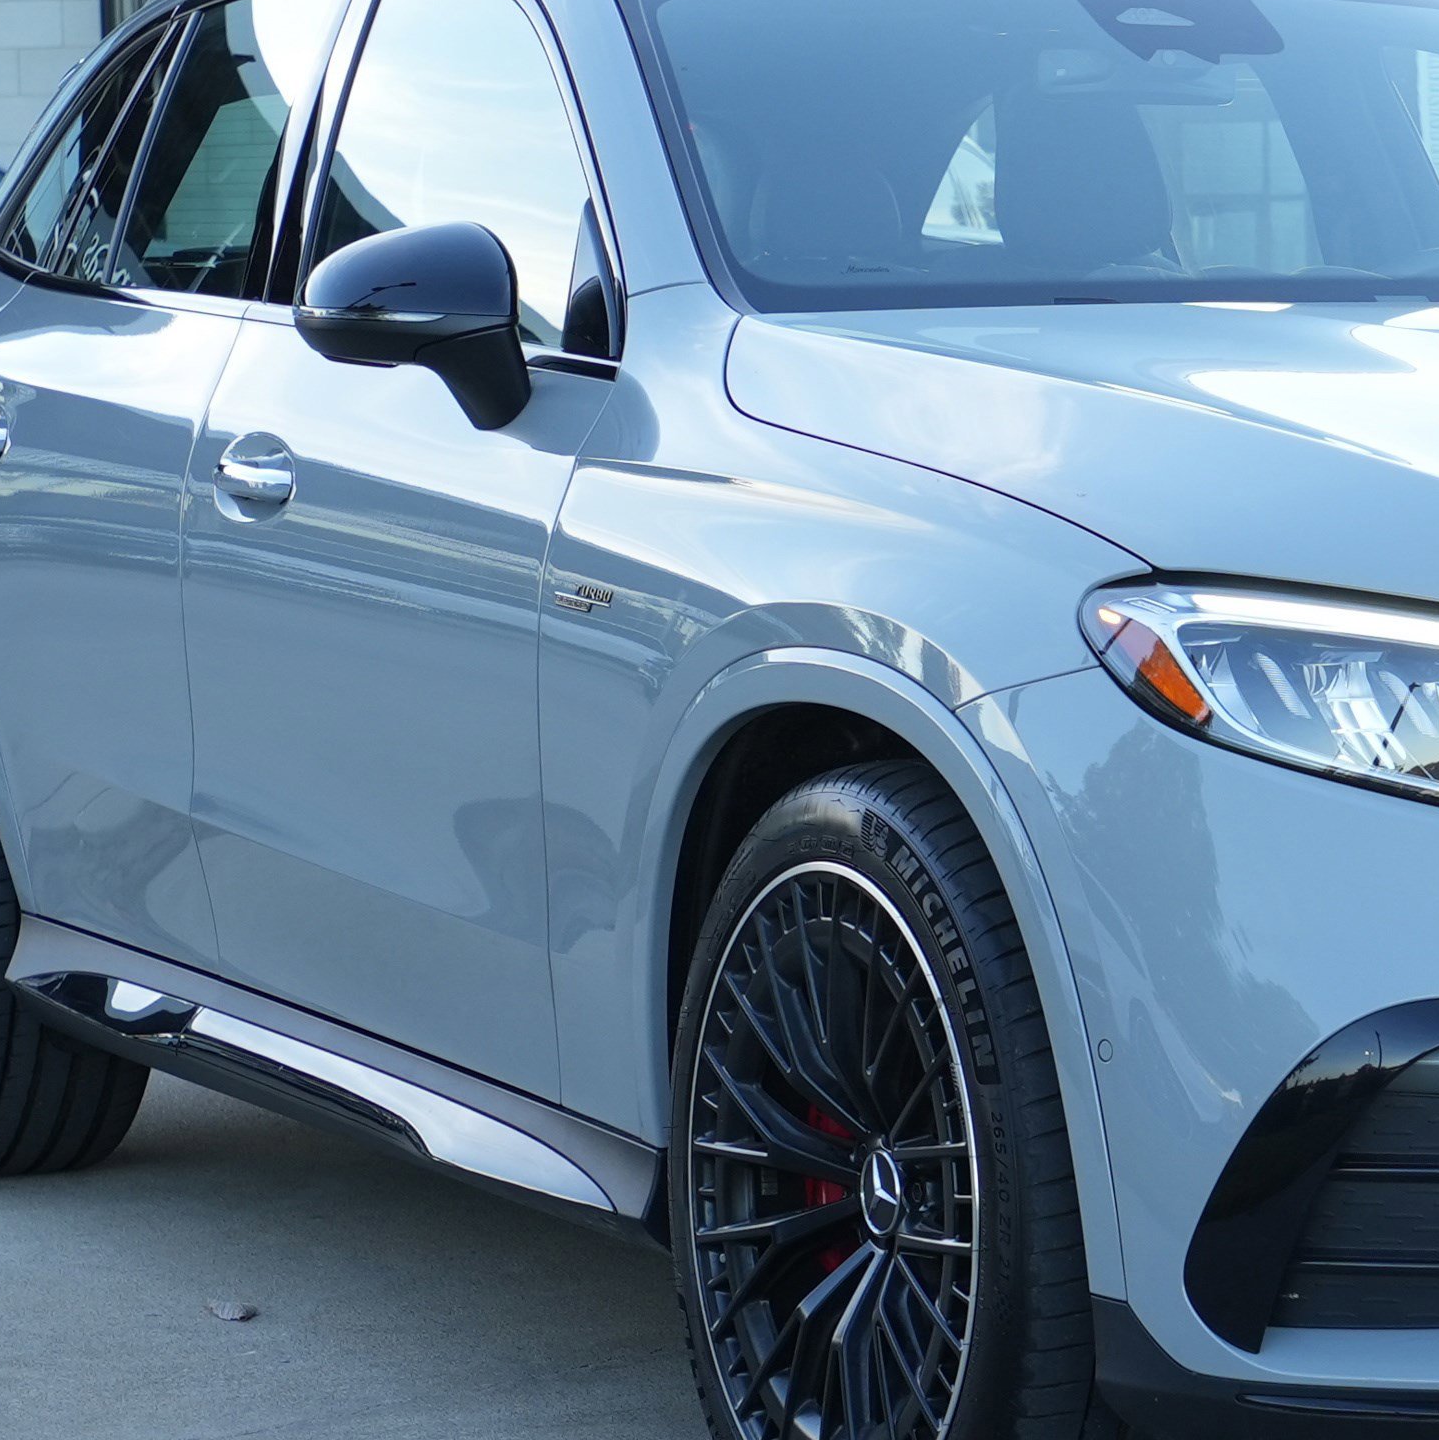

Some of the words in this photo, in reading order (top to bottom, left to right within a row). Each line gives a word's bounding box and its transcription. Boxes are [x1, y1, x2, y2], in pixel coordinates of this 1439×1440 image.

[575, 583, 612, 603] TURBO
[891, 844, 996, 1067] MICHELIN
[990, 1111, 1011, 1203] 265/40
